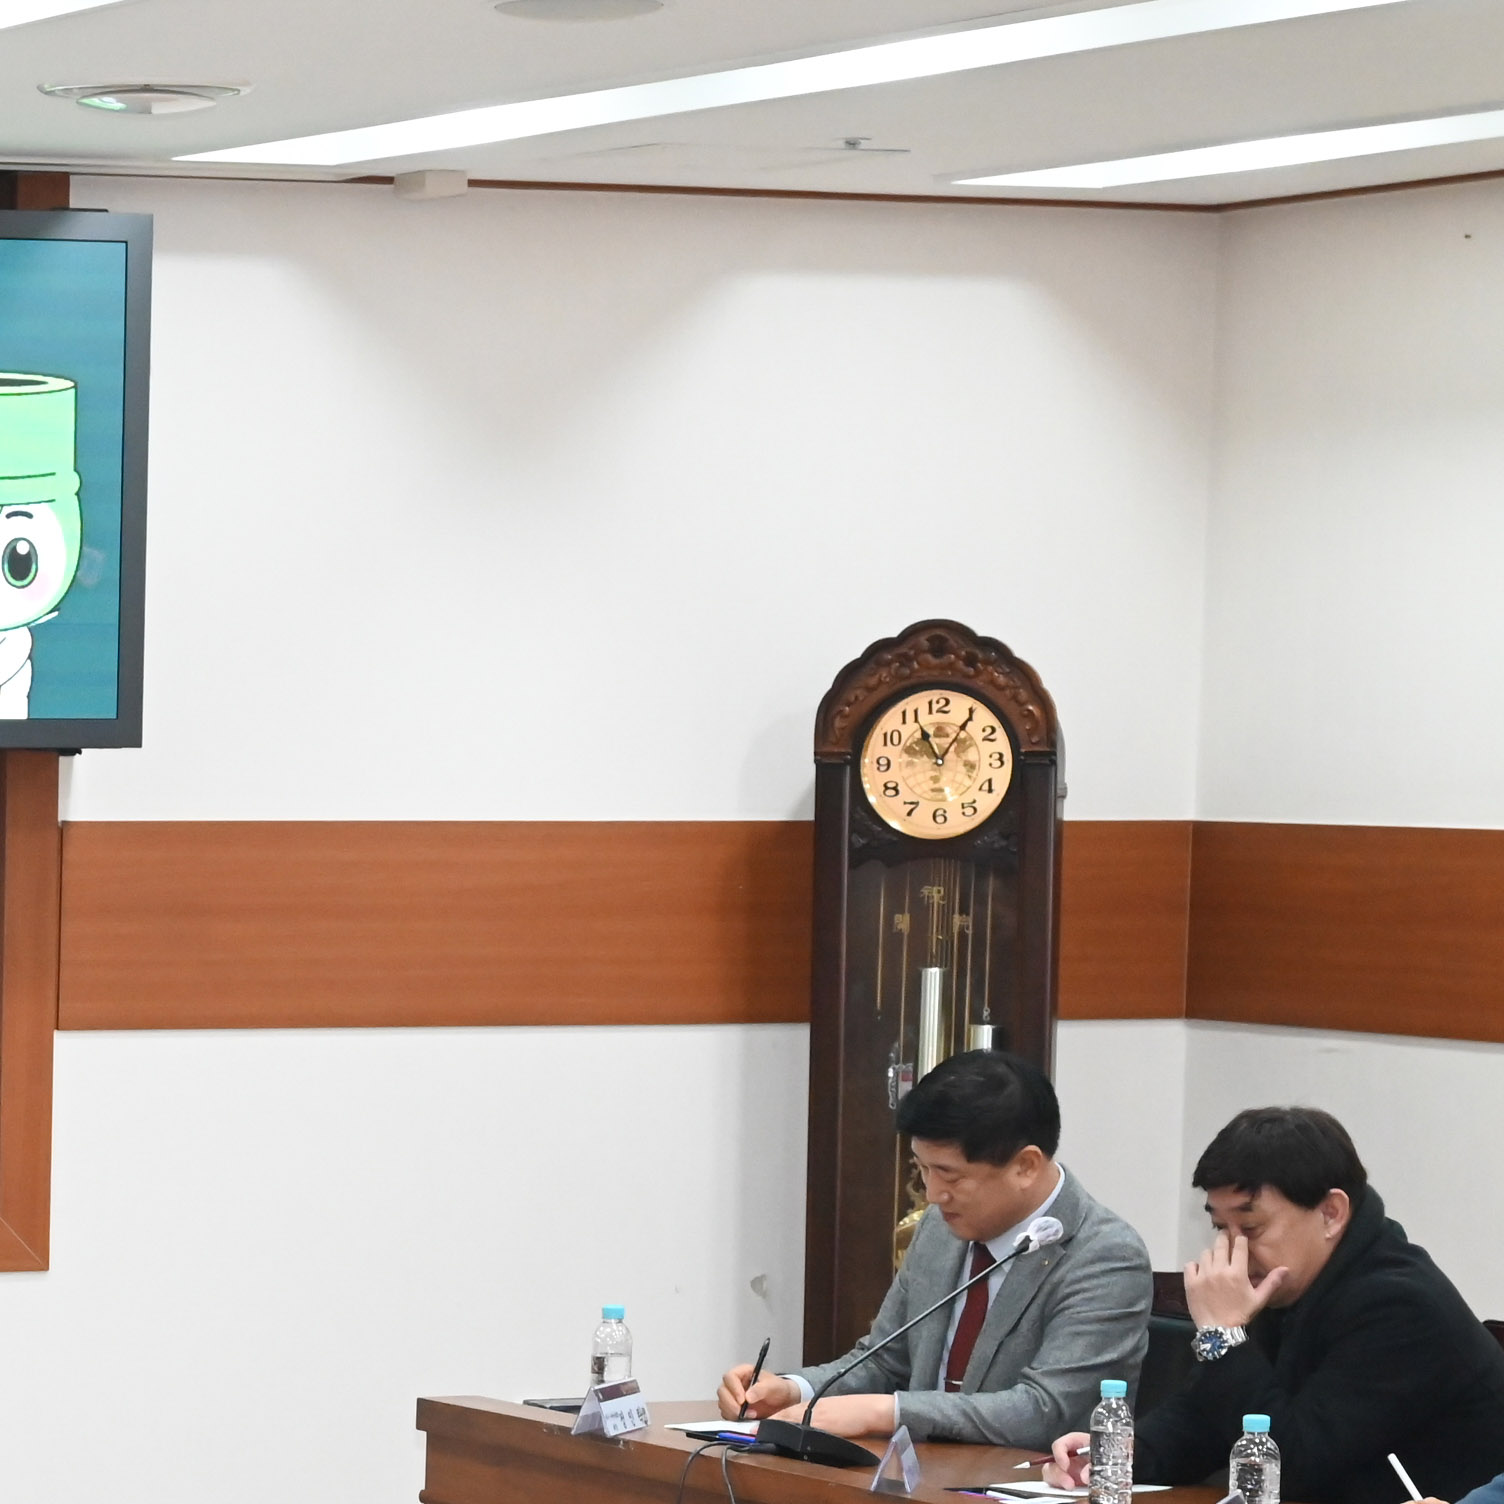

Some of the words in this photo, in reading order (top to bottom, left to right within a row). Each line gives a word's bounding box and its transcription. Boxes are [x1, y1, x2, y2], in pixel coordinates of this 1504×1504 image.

[927, 697, 950, 714] 12
[901, 708, 919, 725] 11
[882, 729, 902, 746] 10
[982, 726, 997, 742] 2
[876, 756, 891, 772] 9
[988, 752, 1005, 769] 3
[882, 781, 900, 797] 8
[978, 778, 995, 794] 4
[903, 801, 920, 817] 7
[932, 808, 948, 825] 6
[961, 799, 978, 817] 5
